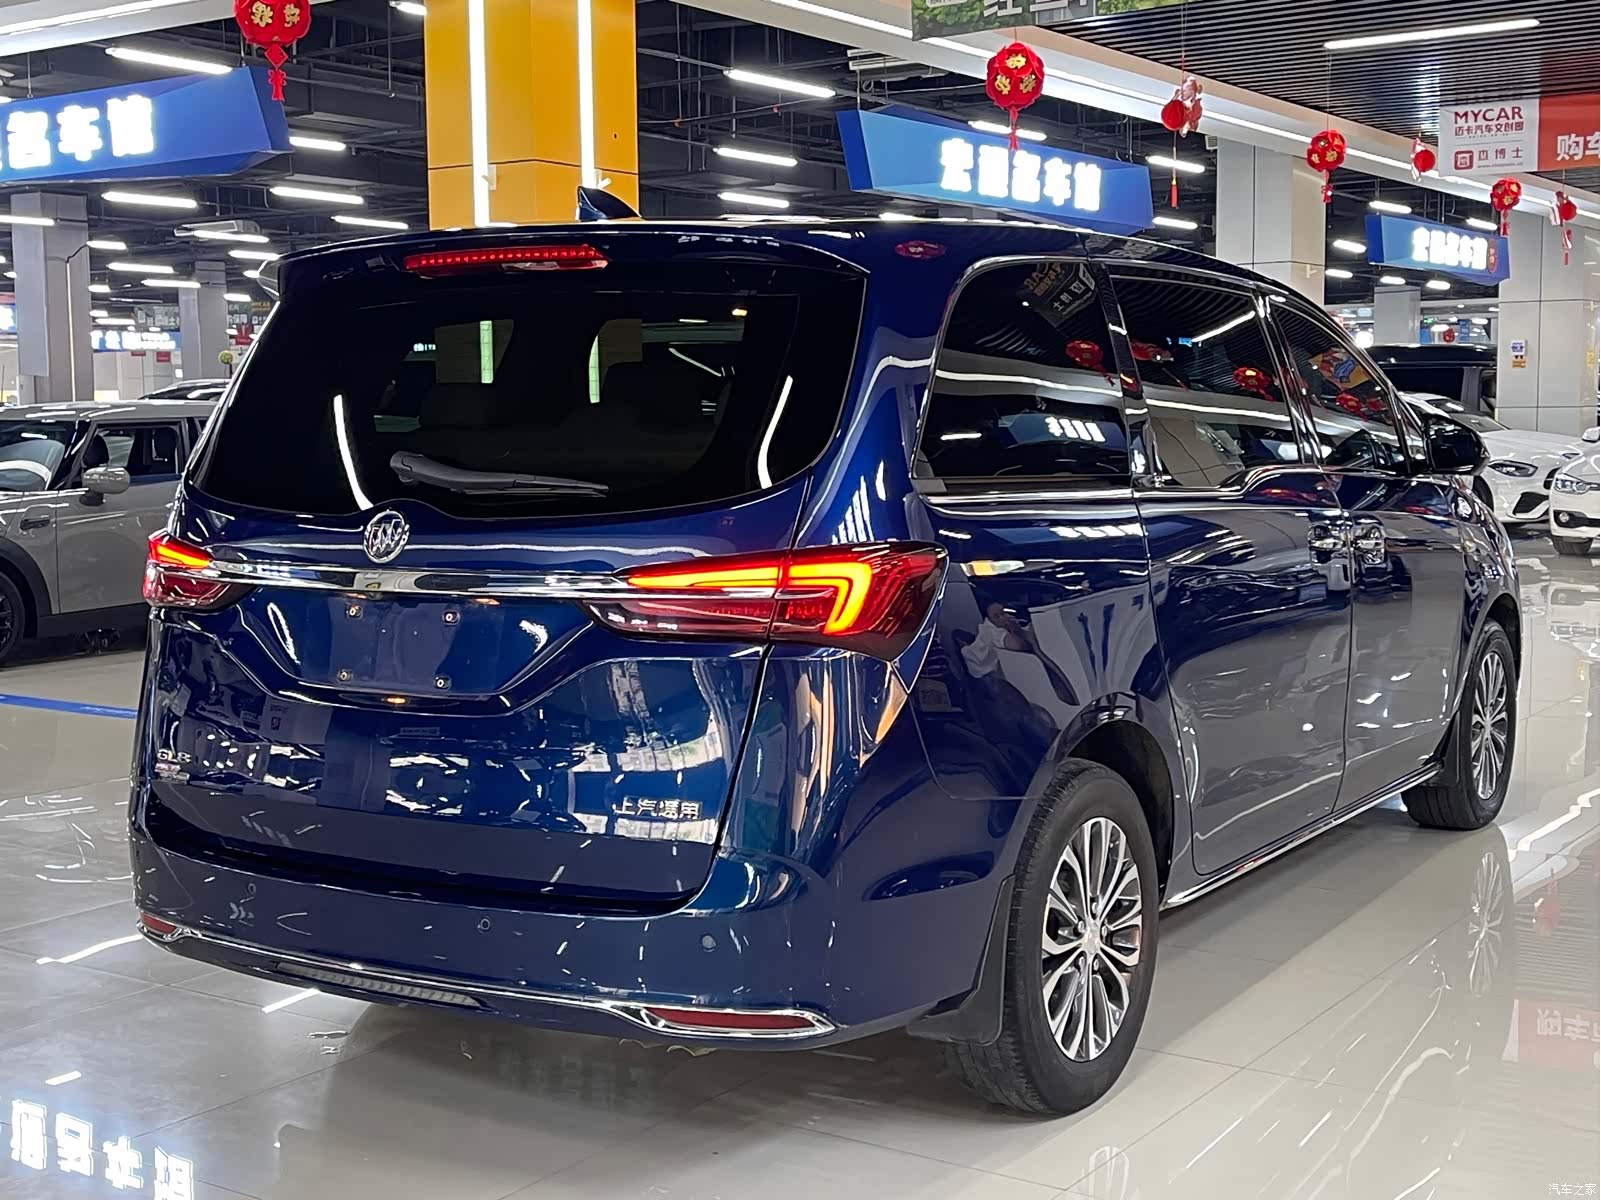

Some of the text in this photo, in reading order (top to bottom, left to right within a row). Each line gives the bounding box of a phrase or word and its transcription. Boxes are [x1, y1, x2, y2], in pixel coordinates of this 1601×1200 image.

[1454, 106, 1524, 125] MYCAR
[0, 94, 154, 170] 名车馆
[1454, 121, 1525, 137] 迈卡汽车文创园
[612, 796, 700, 820] 上汽通用
